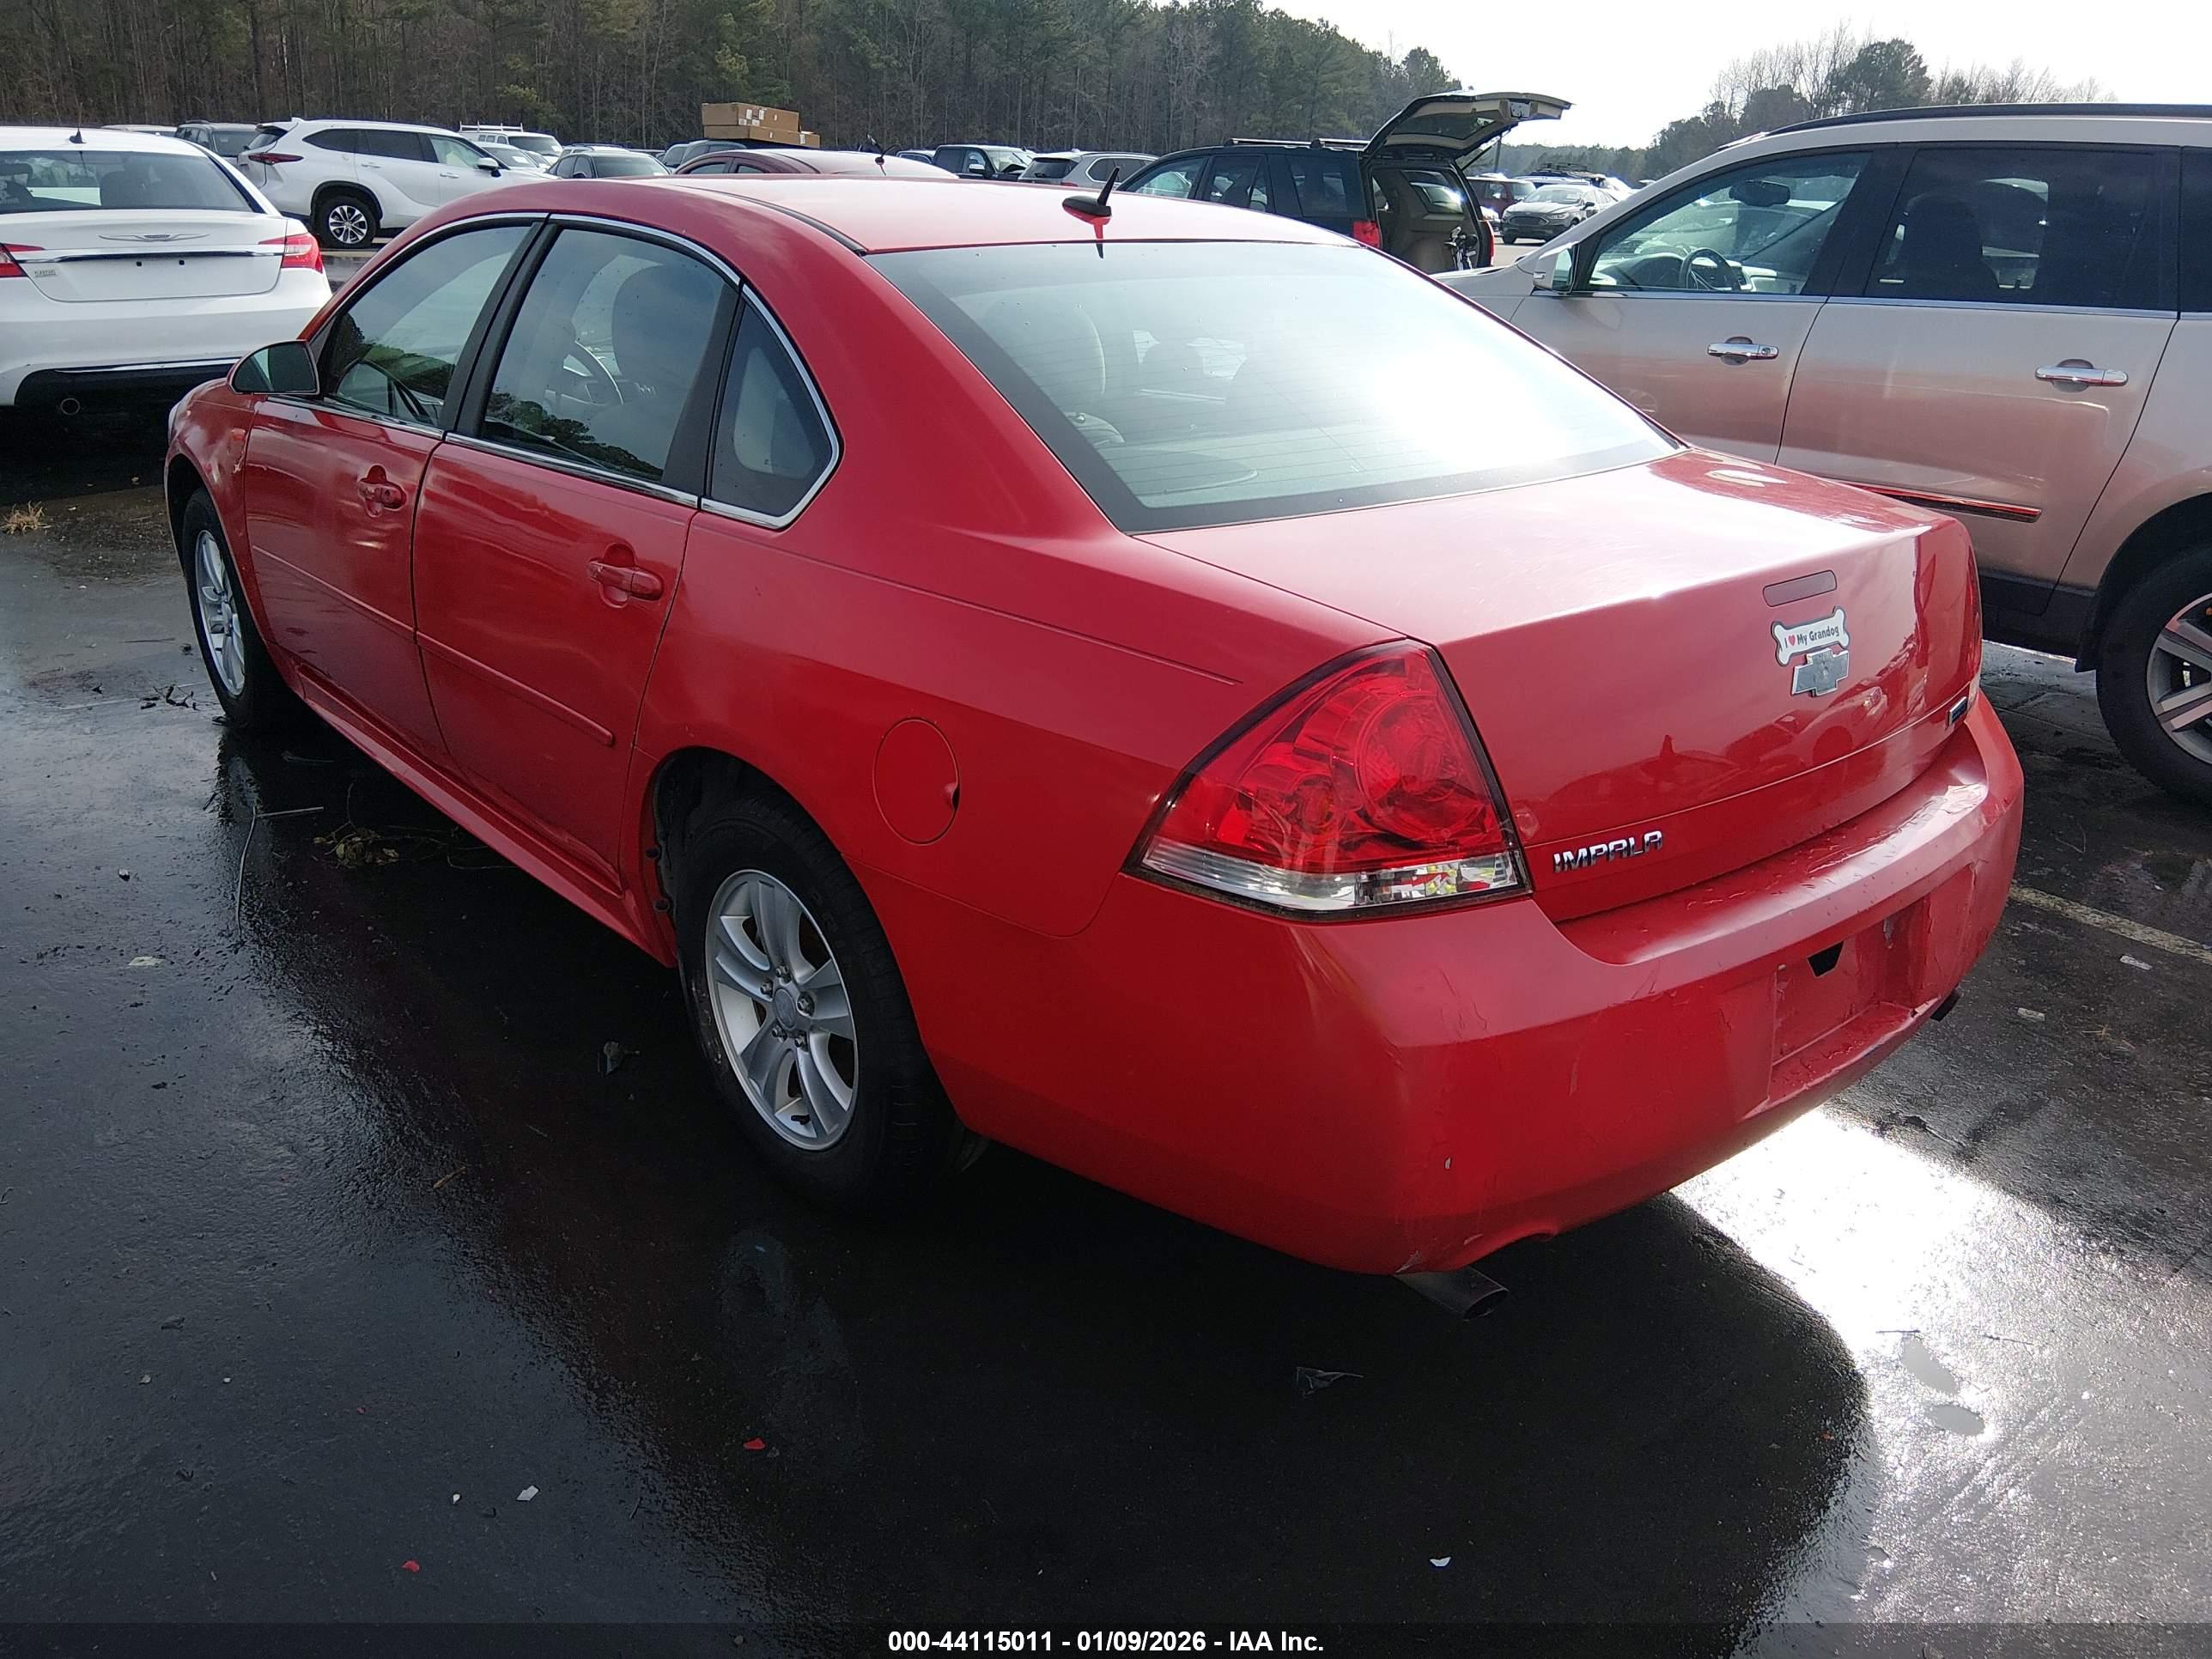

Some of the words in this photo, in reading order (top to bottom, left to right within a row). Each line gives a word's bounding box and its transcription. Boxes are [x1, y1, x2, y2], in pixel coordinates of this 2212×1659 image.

[1796, 634, 1808, 646] My
[1808, 626, 1839, 641] Grandog
[1553, 830, 1662, 873] IMPALA
